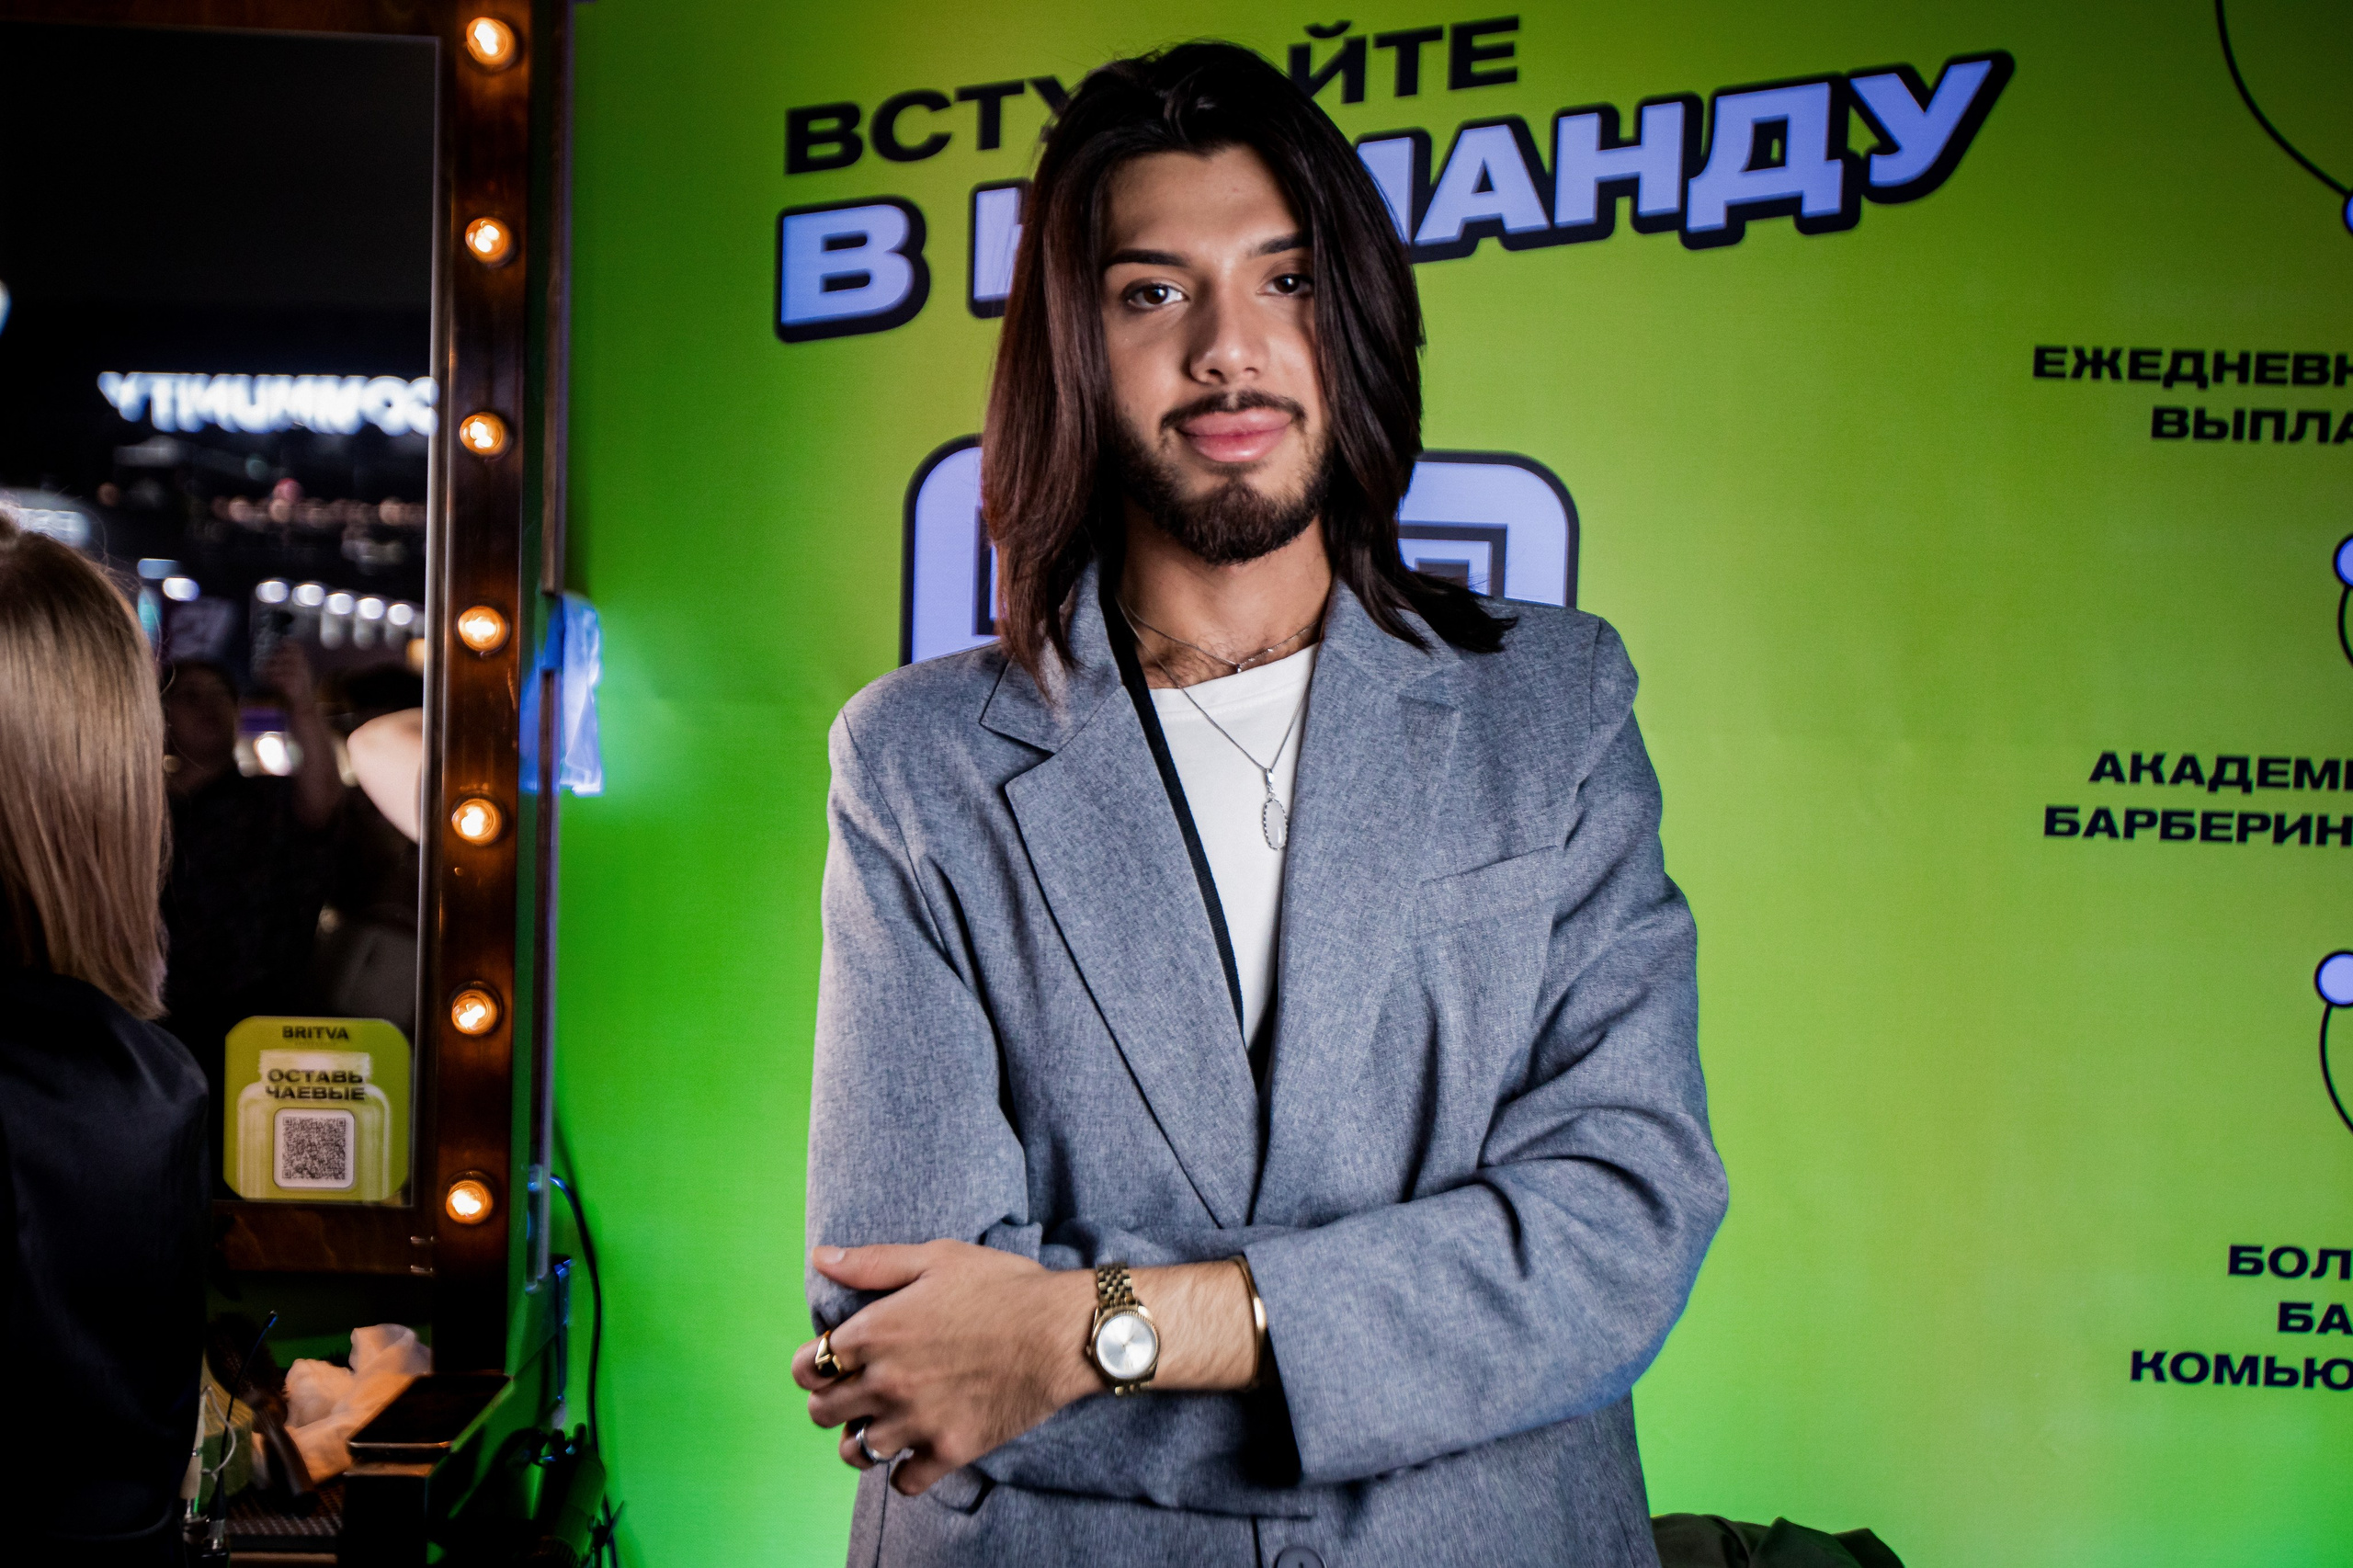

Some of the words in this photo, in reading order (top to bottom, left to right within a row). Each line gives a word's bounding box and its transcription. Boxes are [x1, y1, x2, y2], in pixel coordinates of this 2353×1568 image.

[784, 16, 1519, 175] ВСТЙТЕ
[775, 197, 928, 342] В
[2088, 752, 2353, 795] АКАДЕМ
[2043, 805, 2353, 847] БАРБЕРИН
[281, 1026, 349, 1040] BRITVA
[266, 1085, 366, 1101] ЧАЕВЫЕ
[267, 1068, 364, 1085] ОСТАВЬ
[2228, 1244, 2352, 1280] БОЛ
[2277, 1301, 2353, 1335] БА
[2130, 1350, 2353, 1392] КОМЬЮ
